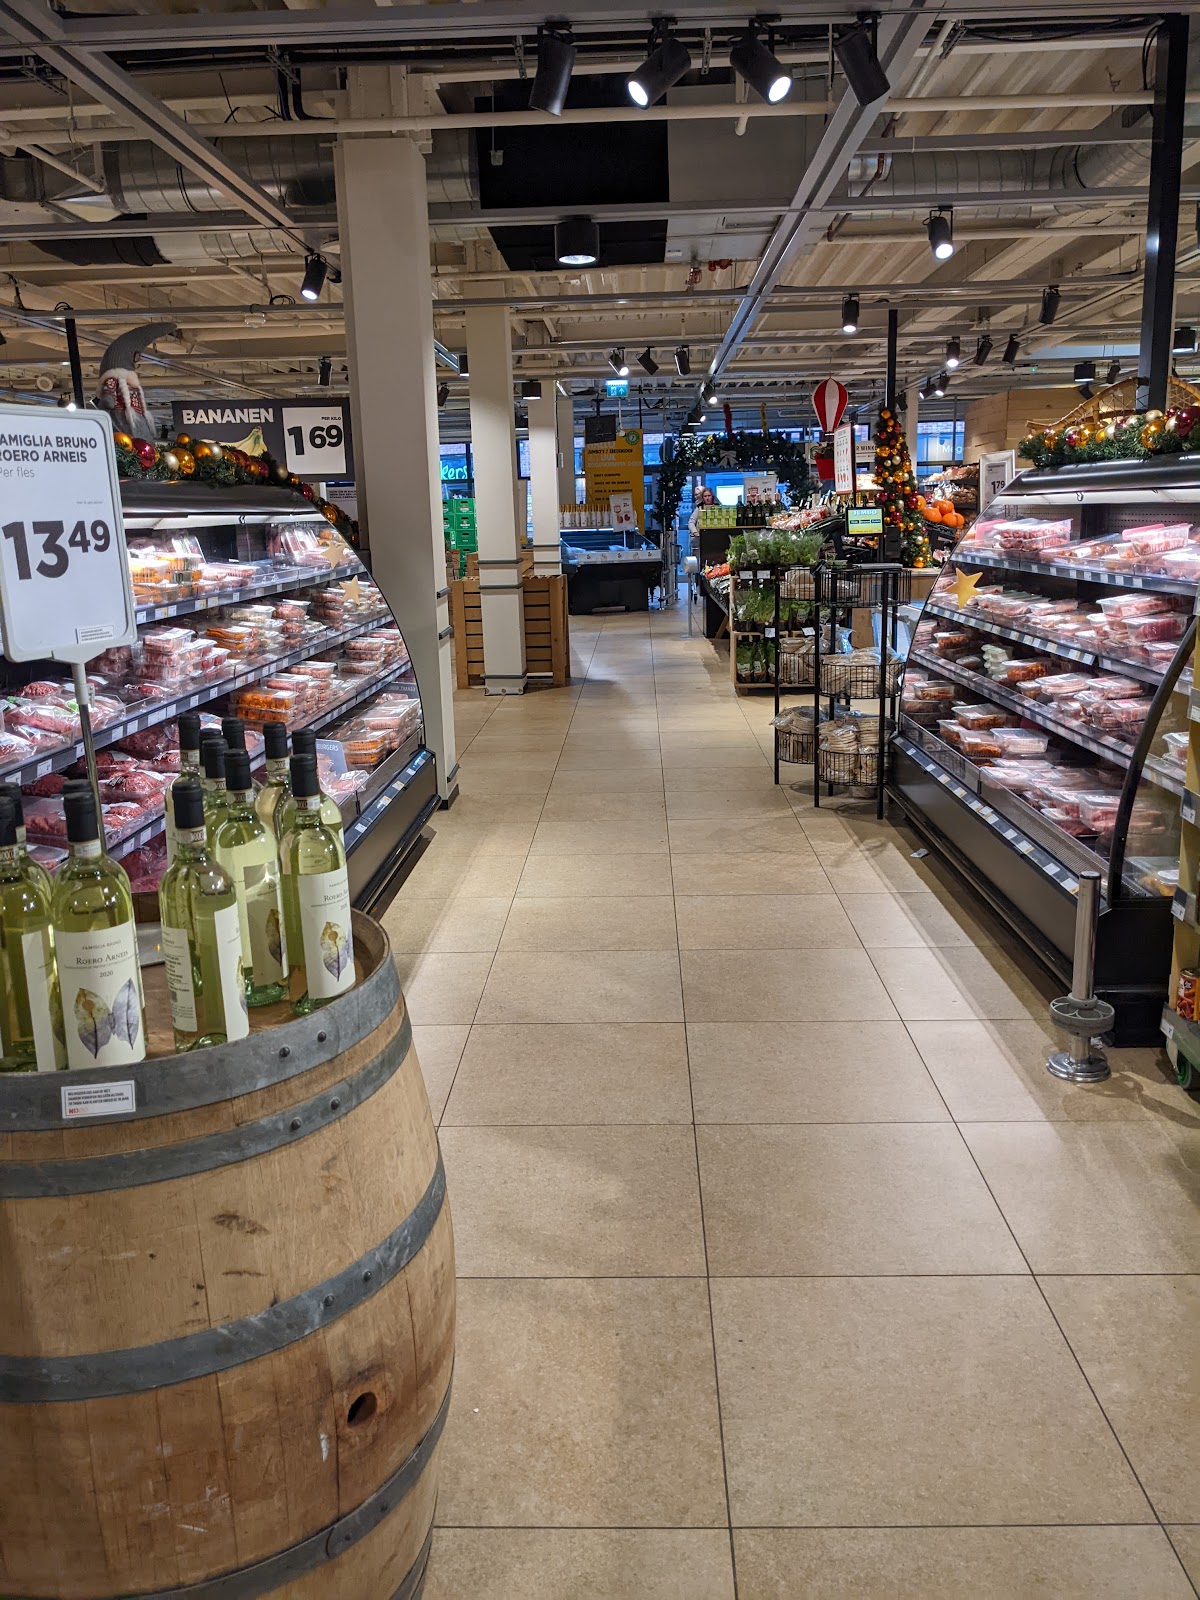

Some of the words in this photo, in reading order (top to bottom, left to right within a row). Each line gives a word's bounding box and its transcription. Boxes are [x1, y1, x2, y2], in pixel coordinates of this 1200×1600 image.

[182, 408, 274, 424] BANANEN
[56, 436, 97, 449] BRUNO
[0, 449, 39, 462] OERO
[44, 451, 88, 463] ARNEIS
[17, 466, 35, 478] fles
[76, 957, 103, 965] ROERO
